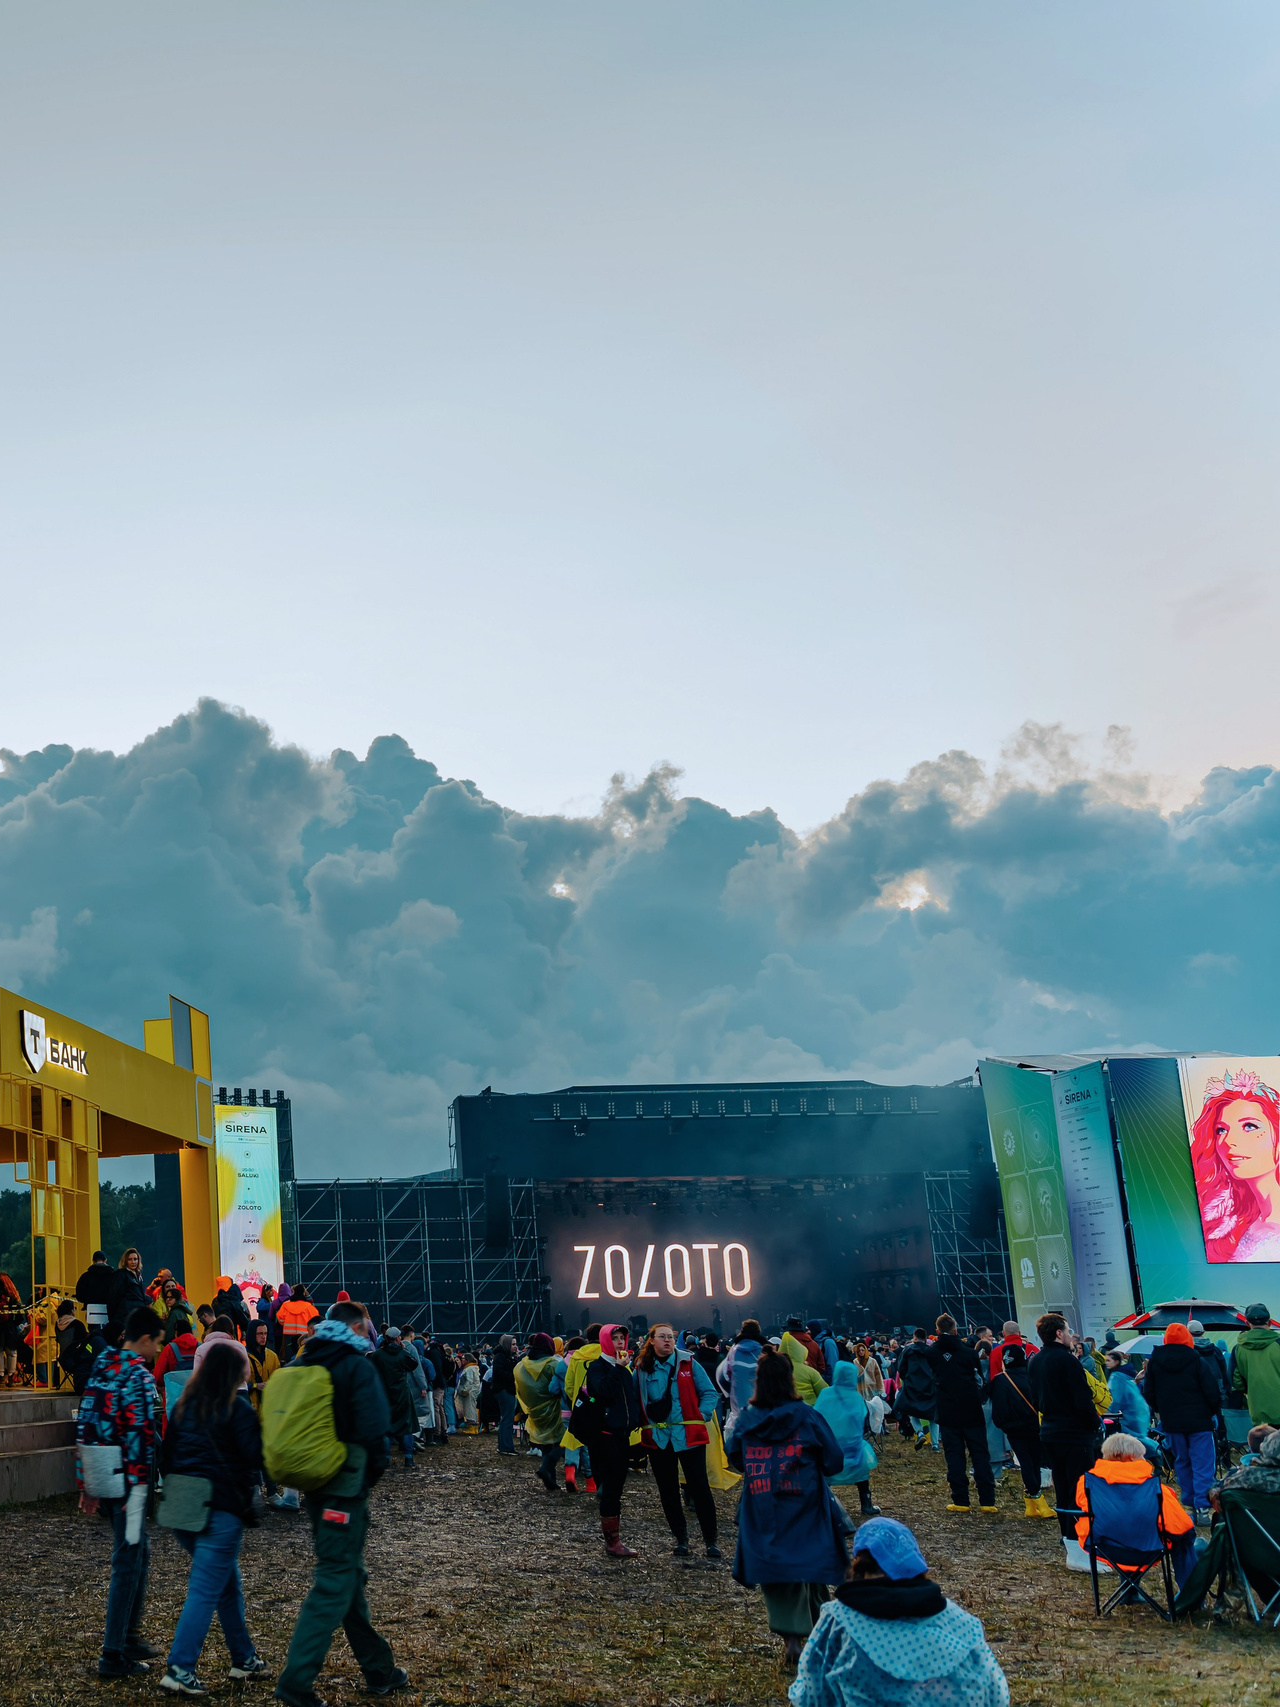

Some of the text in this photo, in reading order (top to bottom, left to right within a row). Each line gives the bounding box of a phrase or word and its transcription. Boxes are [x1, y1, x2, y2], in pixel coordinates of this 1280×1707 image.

[47, 1037, 89, 1076] БАНК
[1065, 1089, 1091, 1105] SIRENA
[225, 1124, 267, 1134] SIRENA
[573, 1242, 752, 1299] ZOLOTO
